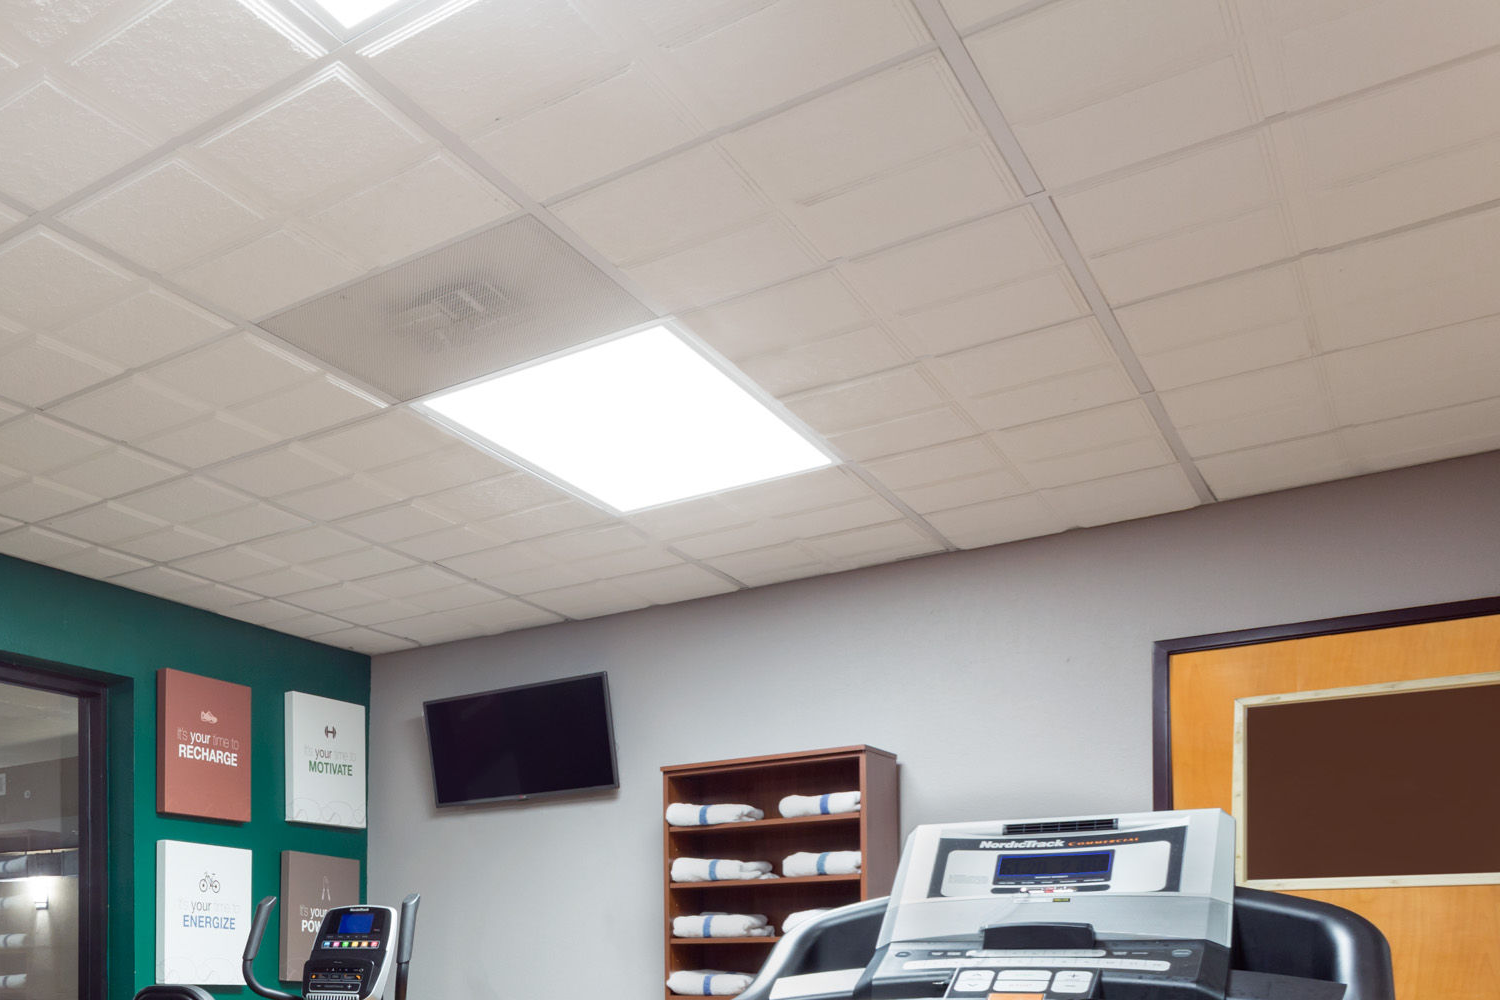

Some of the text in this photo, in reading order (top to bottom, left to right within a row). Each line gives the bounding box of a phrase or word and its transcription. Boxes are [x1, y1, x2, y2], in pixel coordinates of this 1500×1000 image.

[190, 731, 211, 745] your
[178, 743, 238, 768] RECHARGE
[315, 747, 333, 760] your
[308, 759, 353, 777] MOTIVATE
[979, 839, 1065, 849] NordicTrack
[190, 900, 211, 914] your
[183, 914, 236, 931] ENERGIZE
